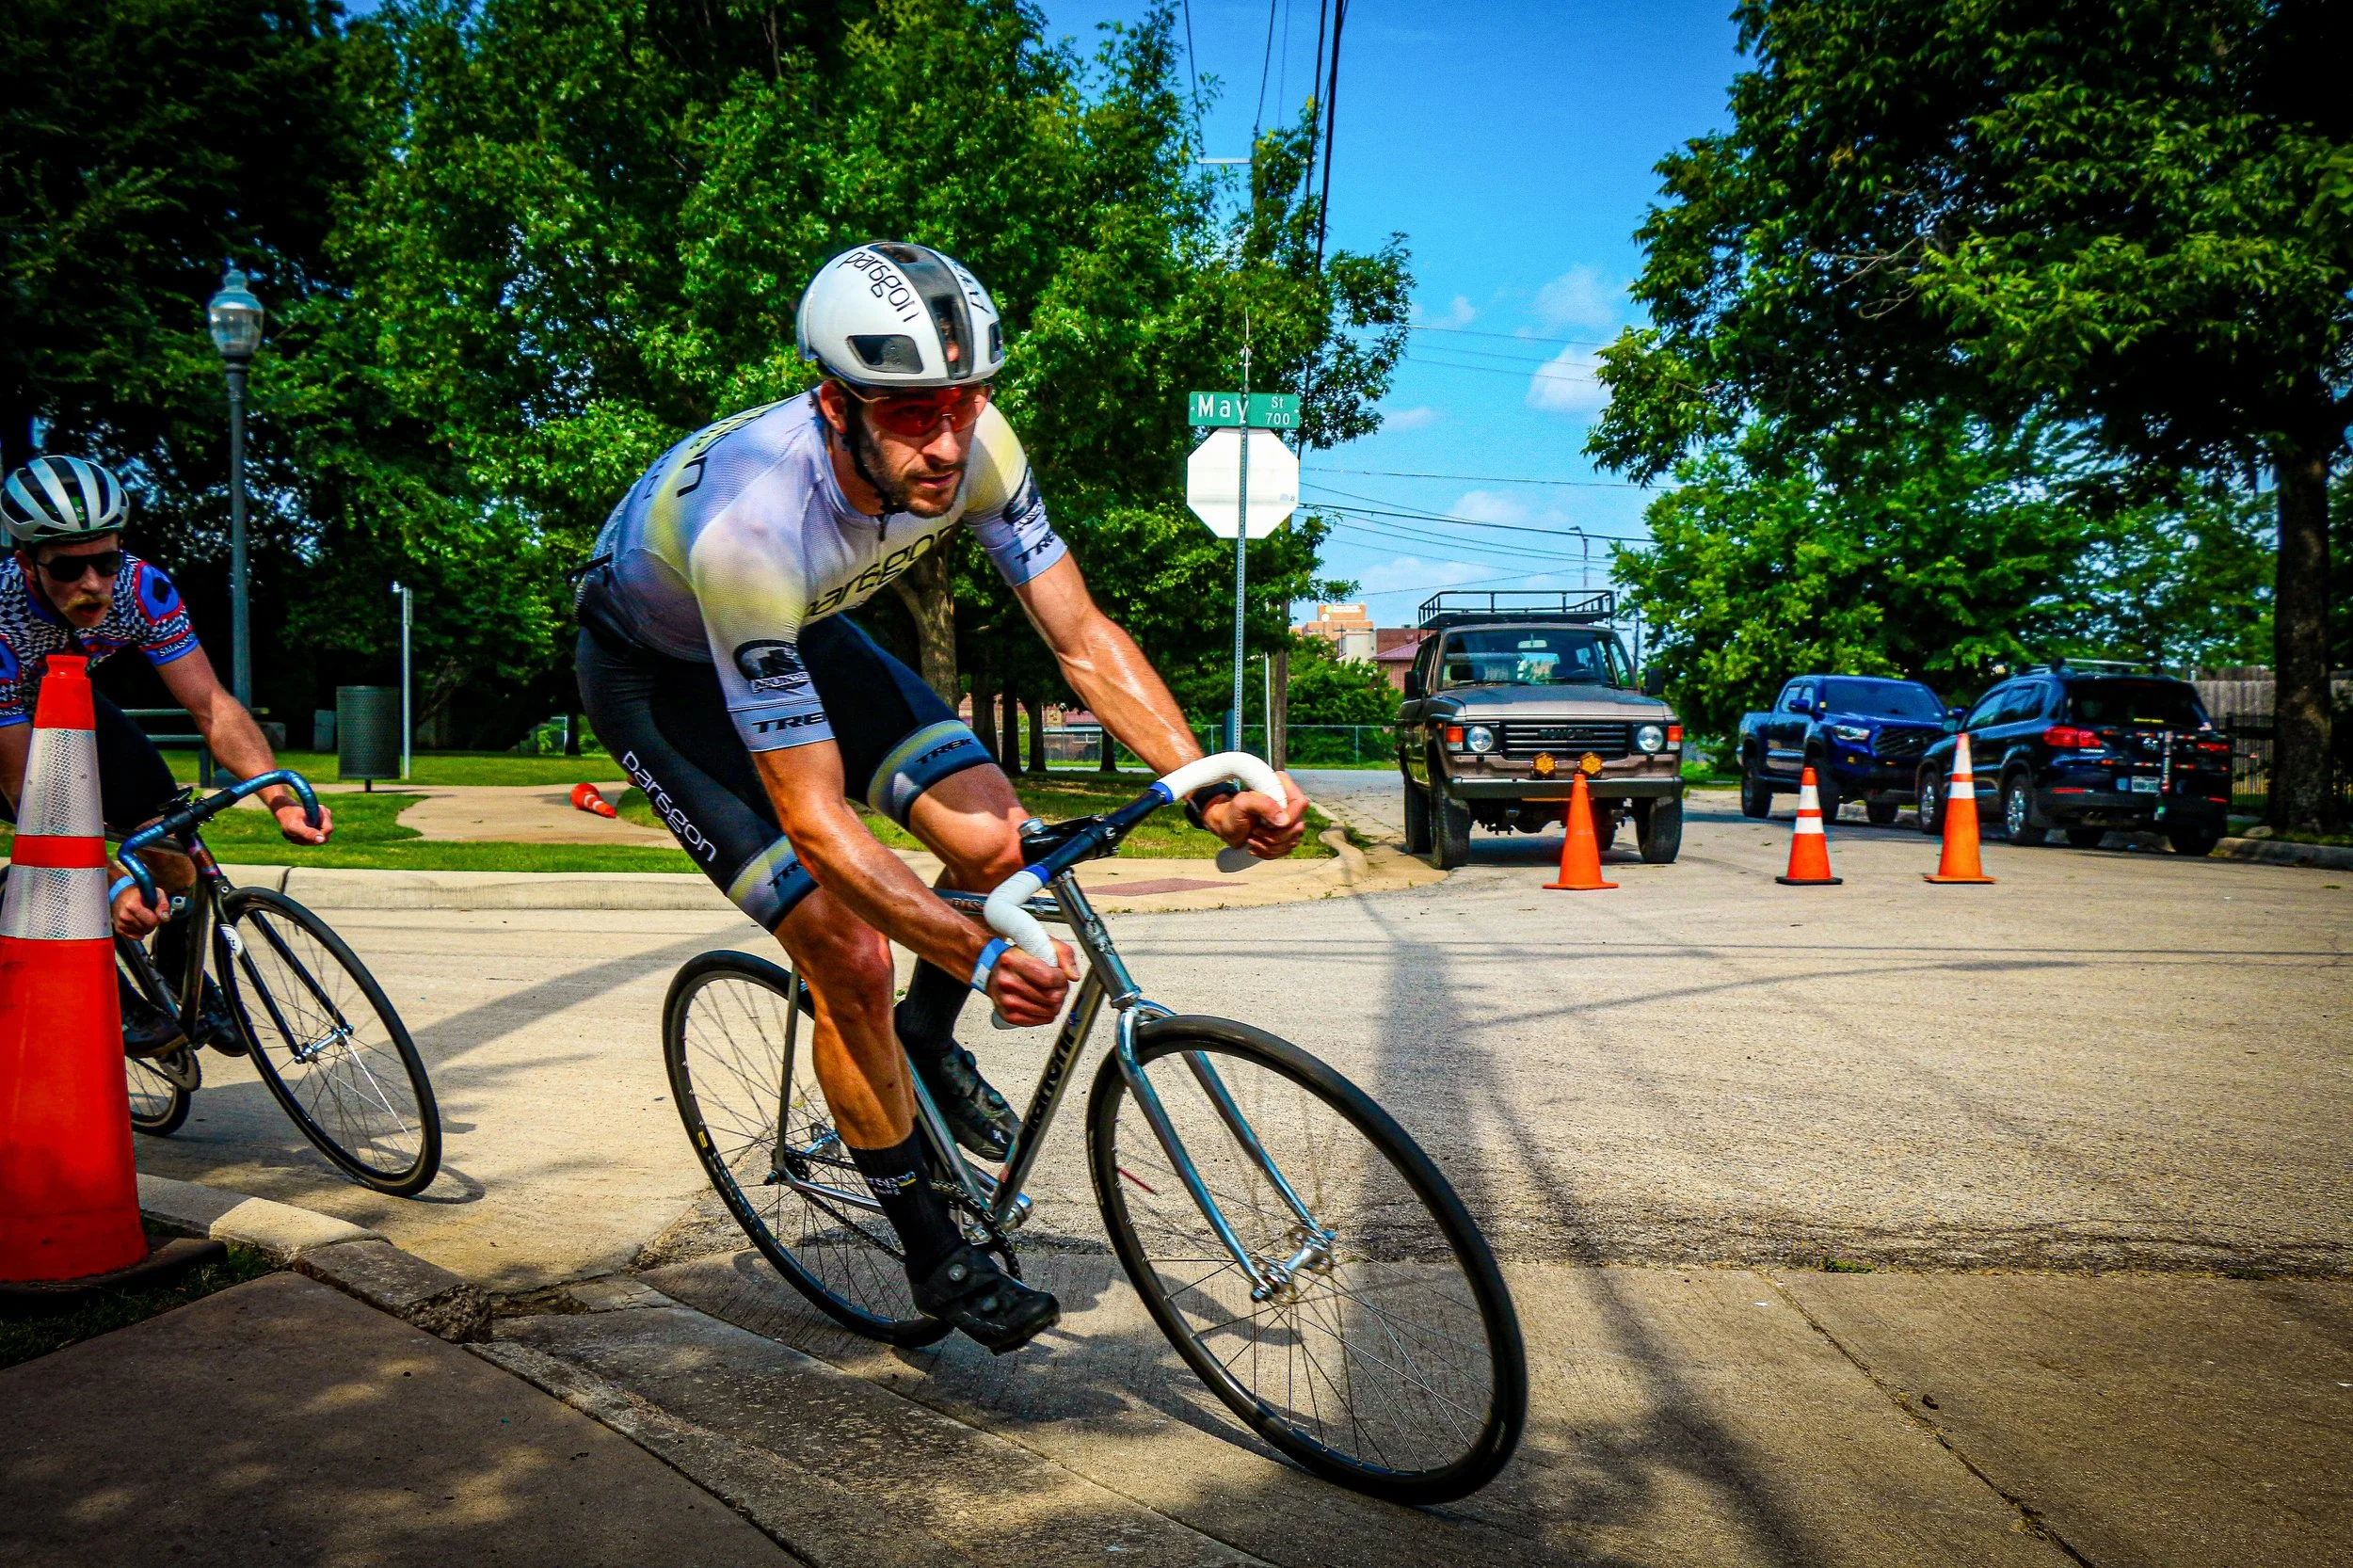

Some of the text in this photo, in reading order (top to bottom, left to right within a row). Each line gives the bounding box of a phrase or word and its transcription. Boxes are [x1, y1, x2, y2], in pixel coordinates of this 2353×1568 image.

[1197, 393, 1284, 424] May St
[1265, 412, 1291, 425] 700
[915, 738, 973, 765] TREK
